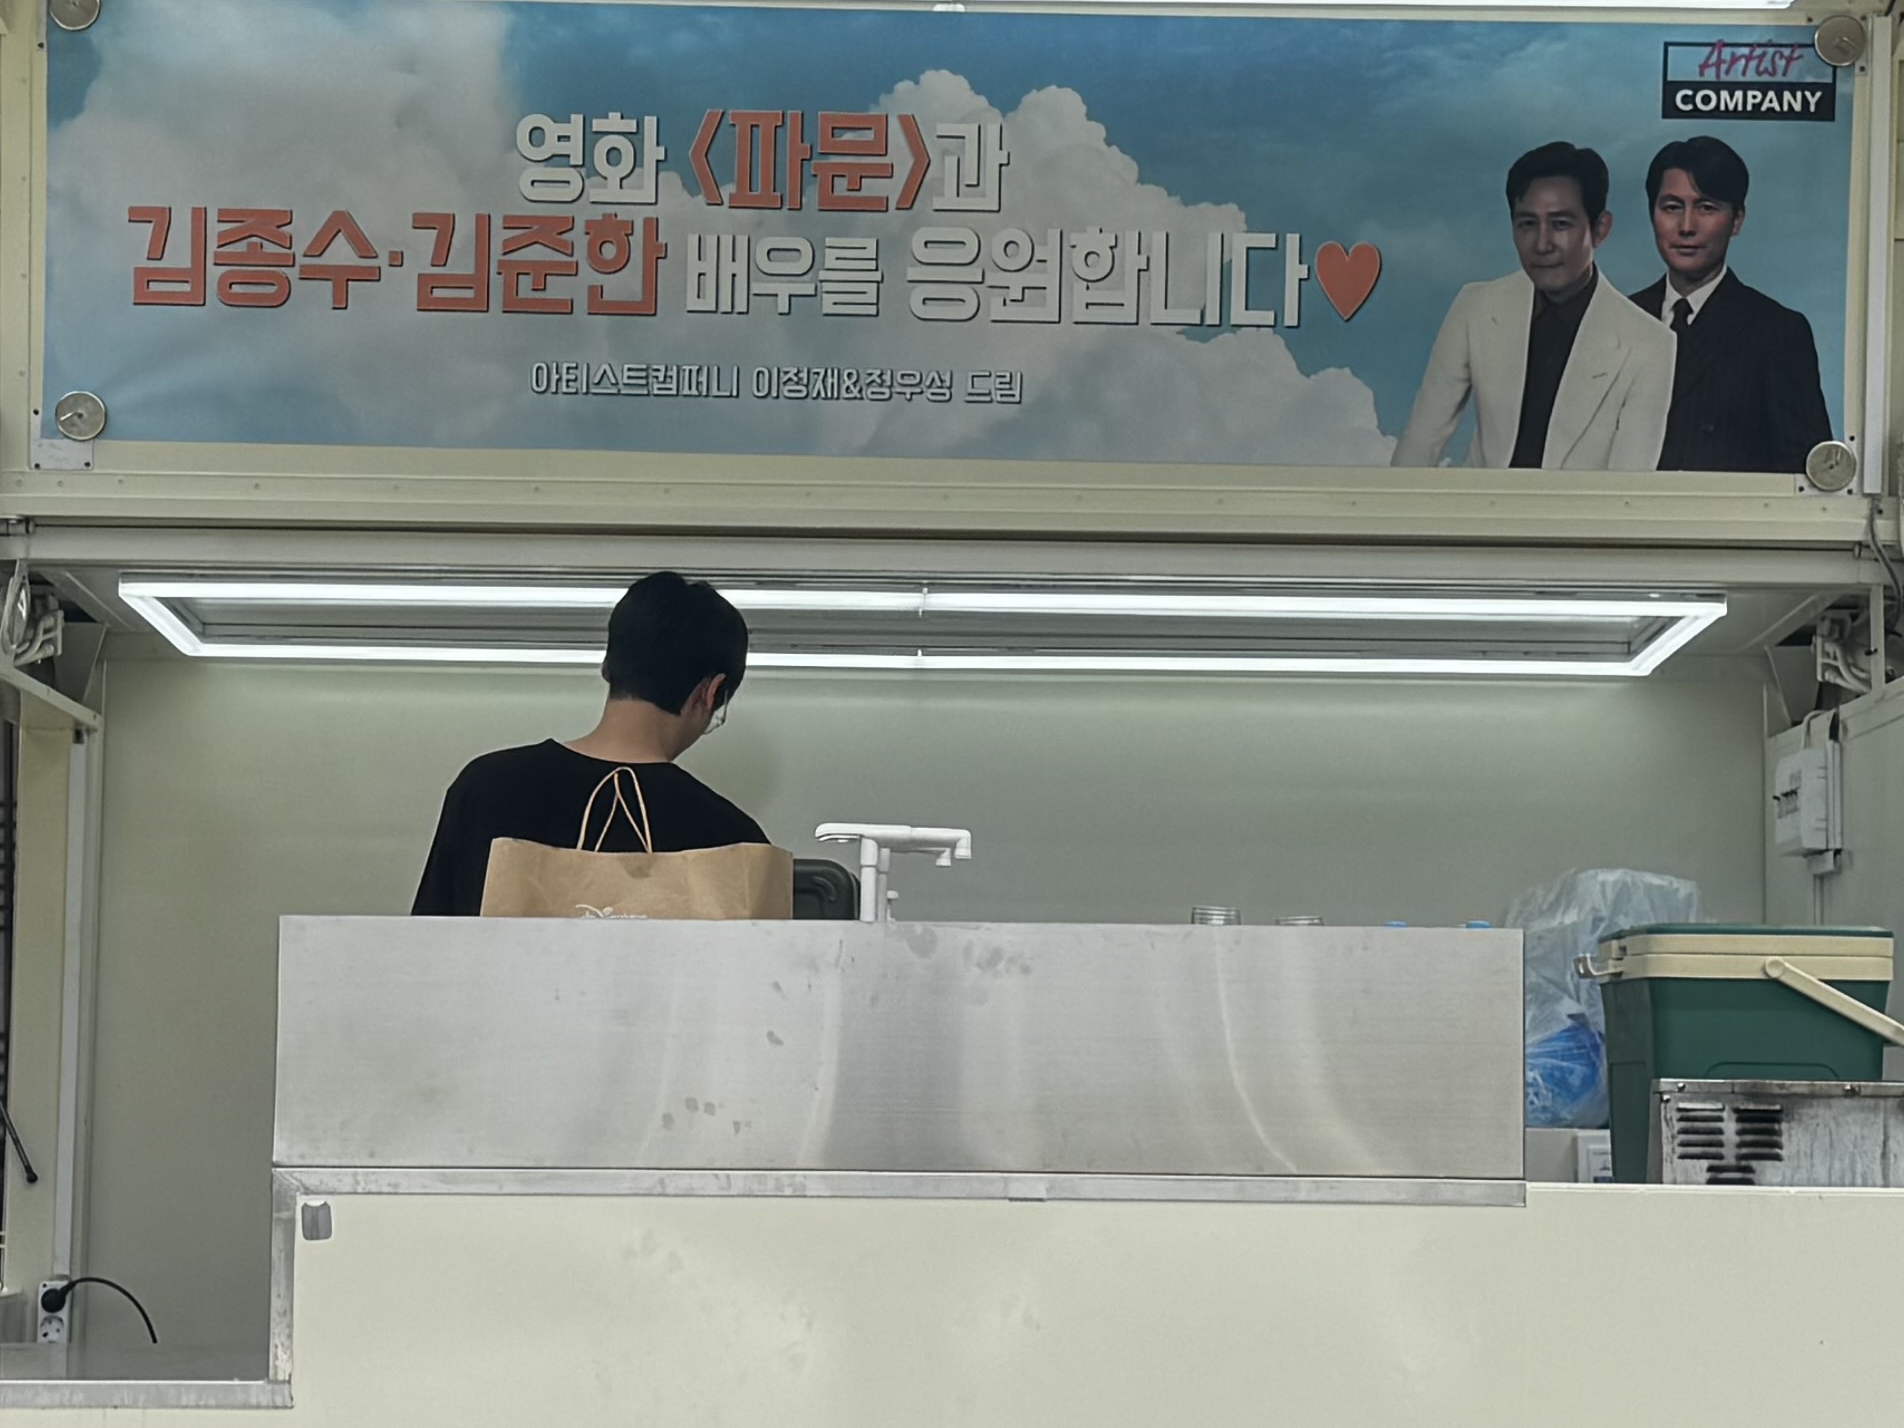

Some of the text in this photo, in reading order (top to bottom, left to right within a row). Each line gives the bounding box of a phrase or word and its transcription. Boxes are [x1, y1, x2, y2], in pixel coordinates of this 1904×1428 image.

[1698, 39, 1803, 80] Artist
[1674, 88, 1823, 113] COMPANY
[515, 111, 667, 206] 영화
[127, 205, 1310, 329] 김종수·김준한 배우를 응원합니다
[529, 360, 1024, 405] 아티스트컴퍼니 이정재&정우성 드림
